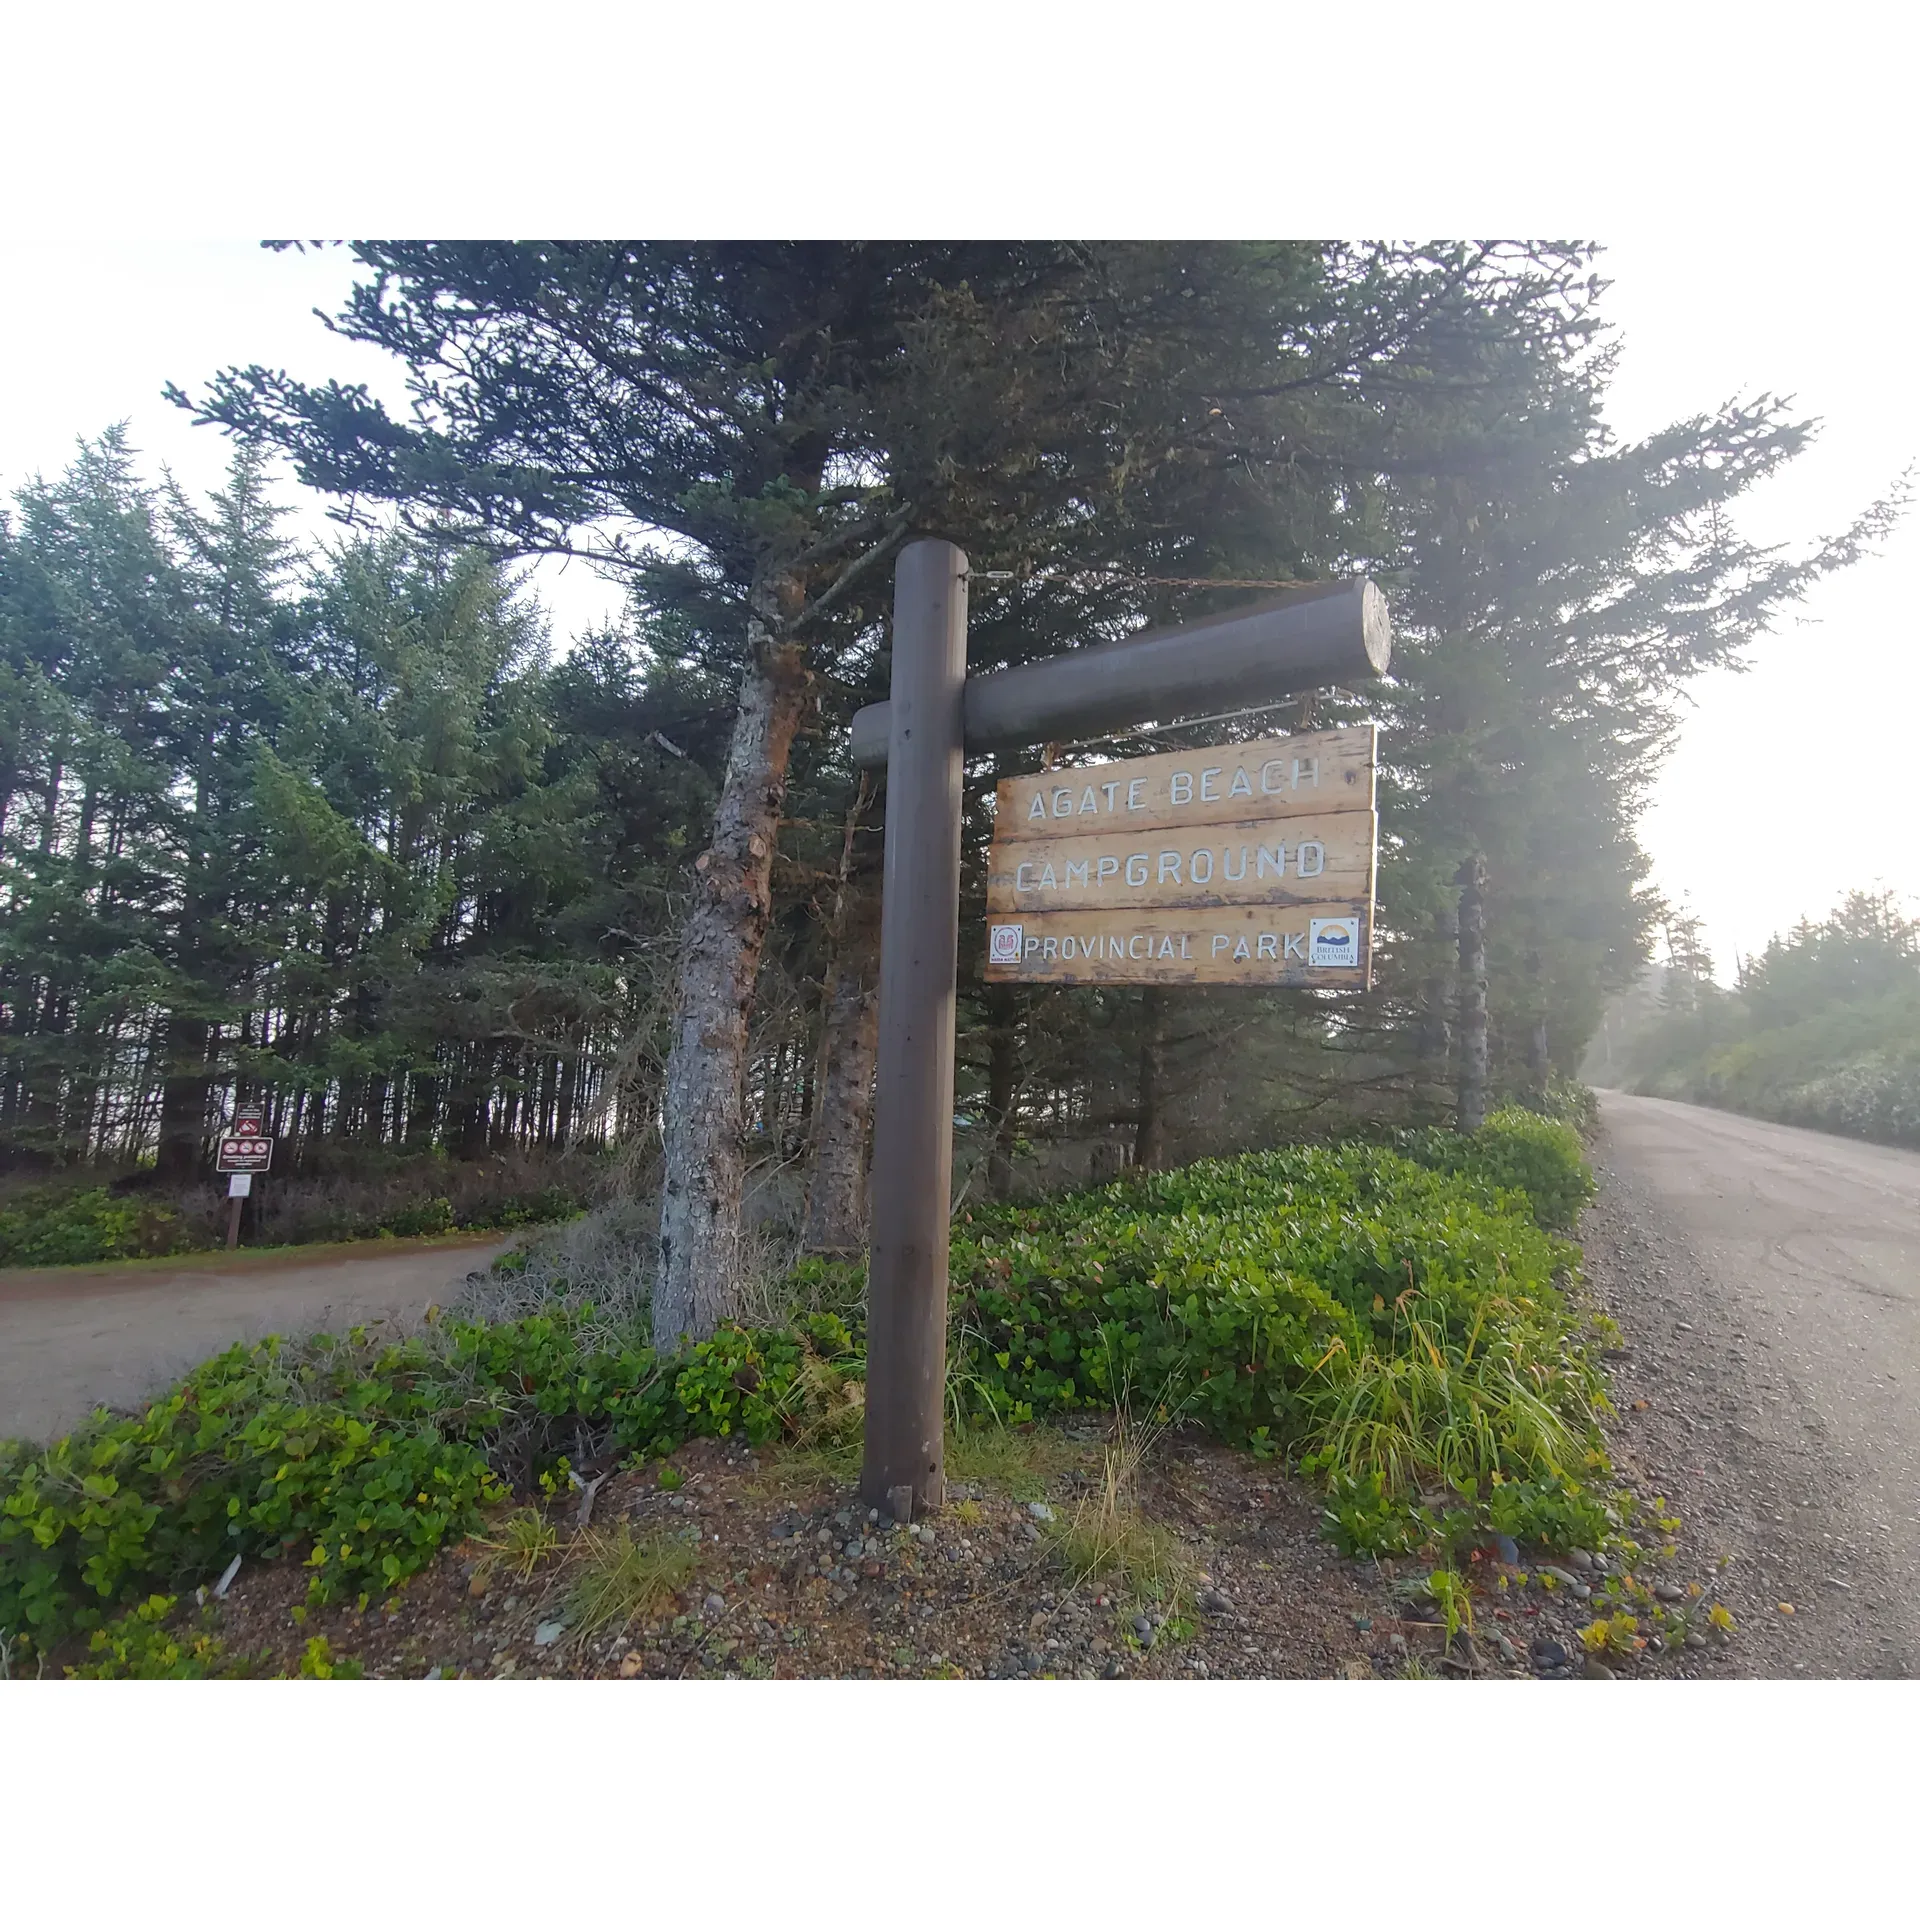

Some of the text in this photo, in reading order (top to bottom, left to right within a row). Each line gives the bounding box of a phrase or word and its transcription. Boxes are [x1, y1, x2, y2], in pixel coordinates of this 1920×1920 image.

[1027, 758, 1320, 821] AGATE BEACH
[1015, 840, 1326, 893] CAMPGROUND
[1024, 932, 1306, 961] PROVINCIAL PARK
[1311, 953, 1355, 961] COLUMBIA
[1316, 946, 1351, 954] BRITISH
